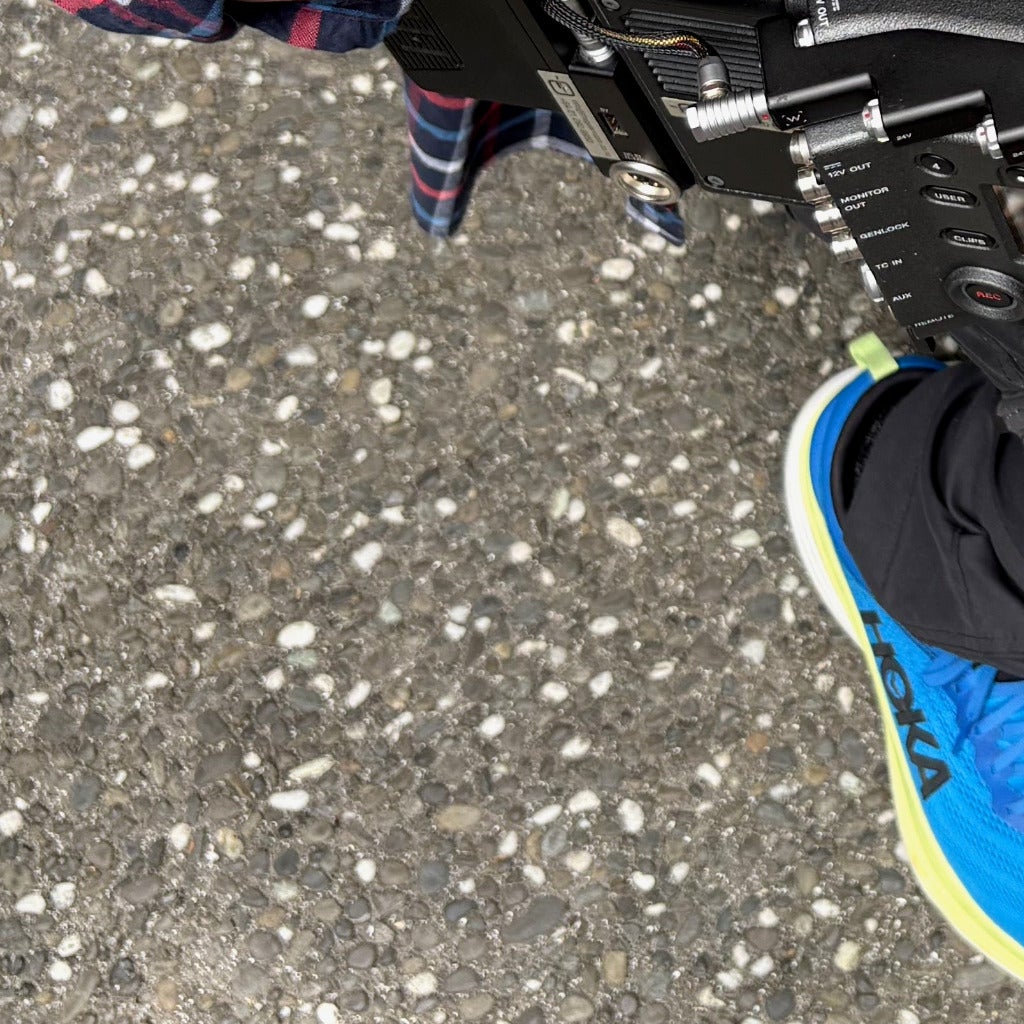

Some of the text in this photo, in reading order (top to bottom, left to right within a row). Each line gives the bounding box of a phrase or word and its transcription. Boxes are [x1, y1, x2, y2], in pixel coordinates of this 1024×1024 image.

[817, 7, 830, 26] OUT
[827, 162, 872, 178] 12V OUT
[840, 186, 890, 203] MONITOR
[934, 193, 967, 203] USER
[844, 201, 867, 212] OUT
[859, 222, 911, 239] GENLOCK
[953, 234, 986, 245] CLIPS
[875, 258, 903, 270] TC IN
[892, 292, 913, 302] AUX
[976, 289, 1002, 302] REC
[860, 610, 952, 800] HOKA
